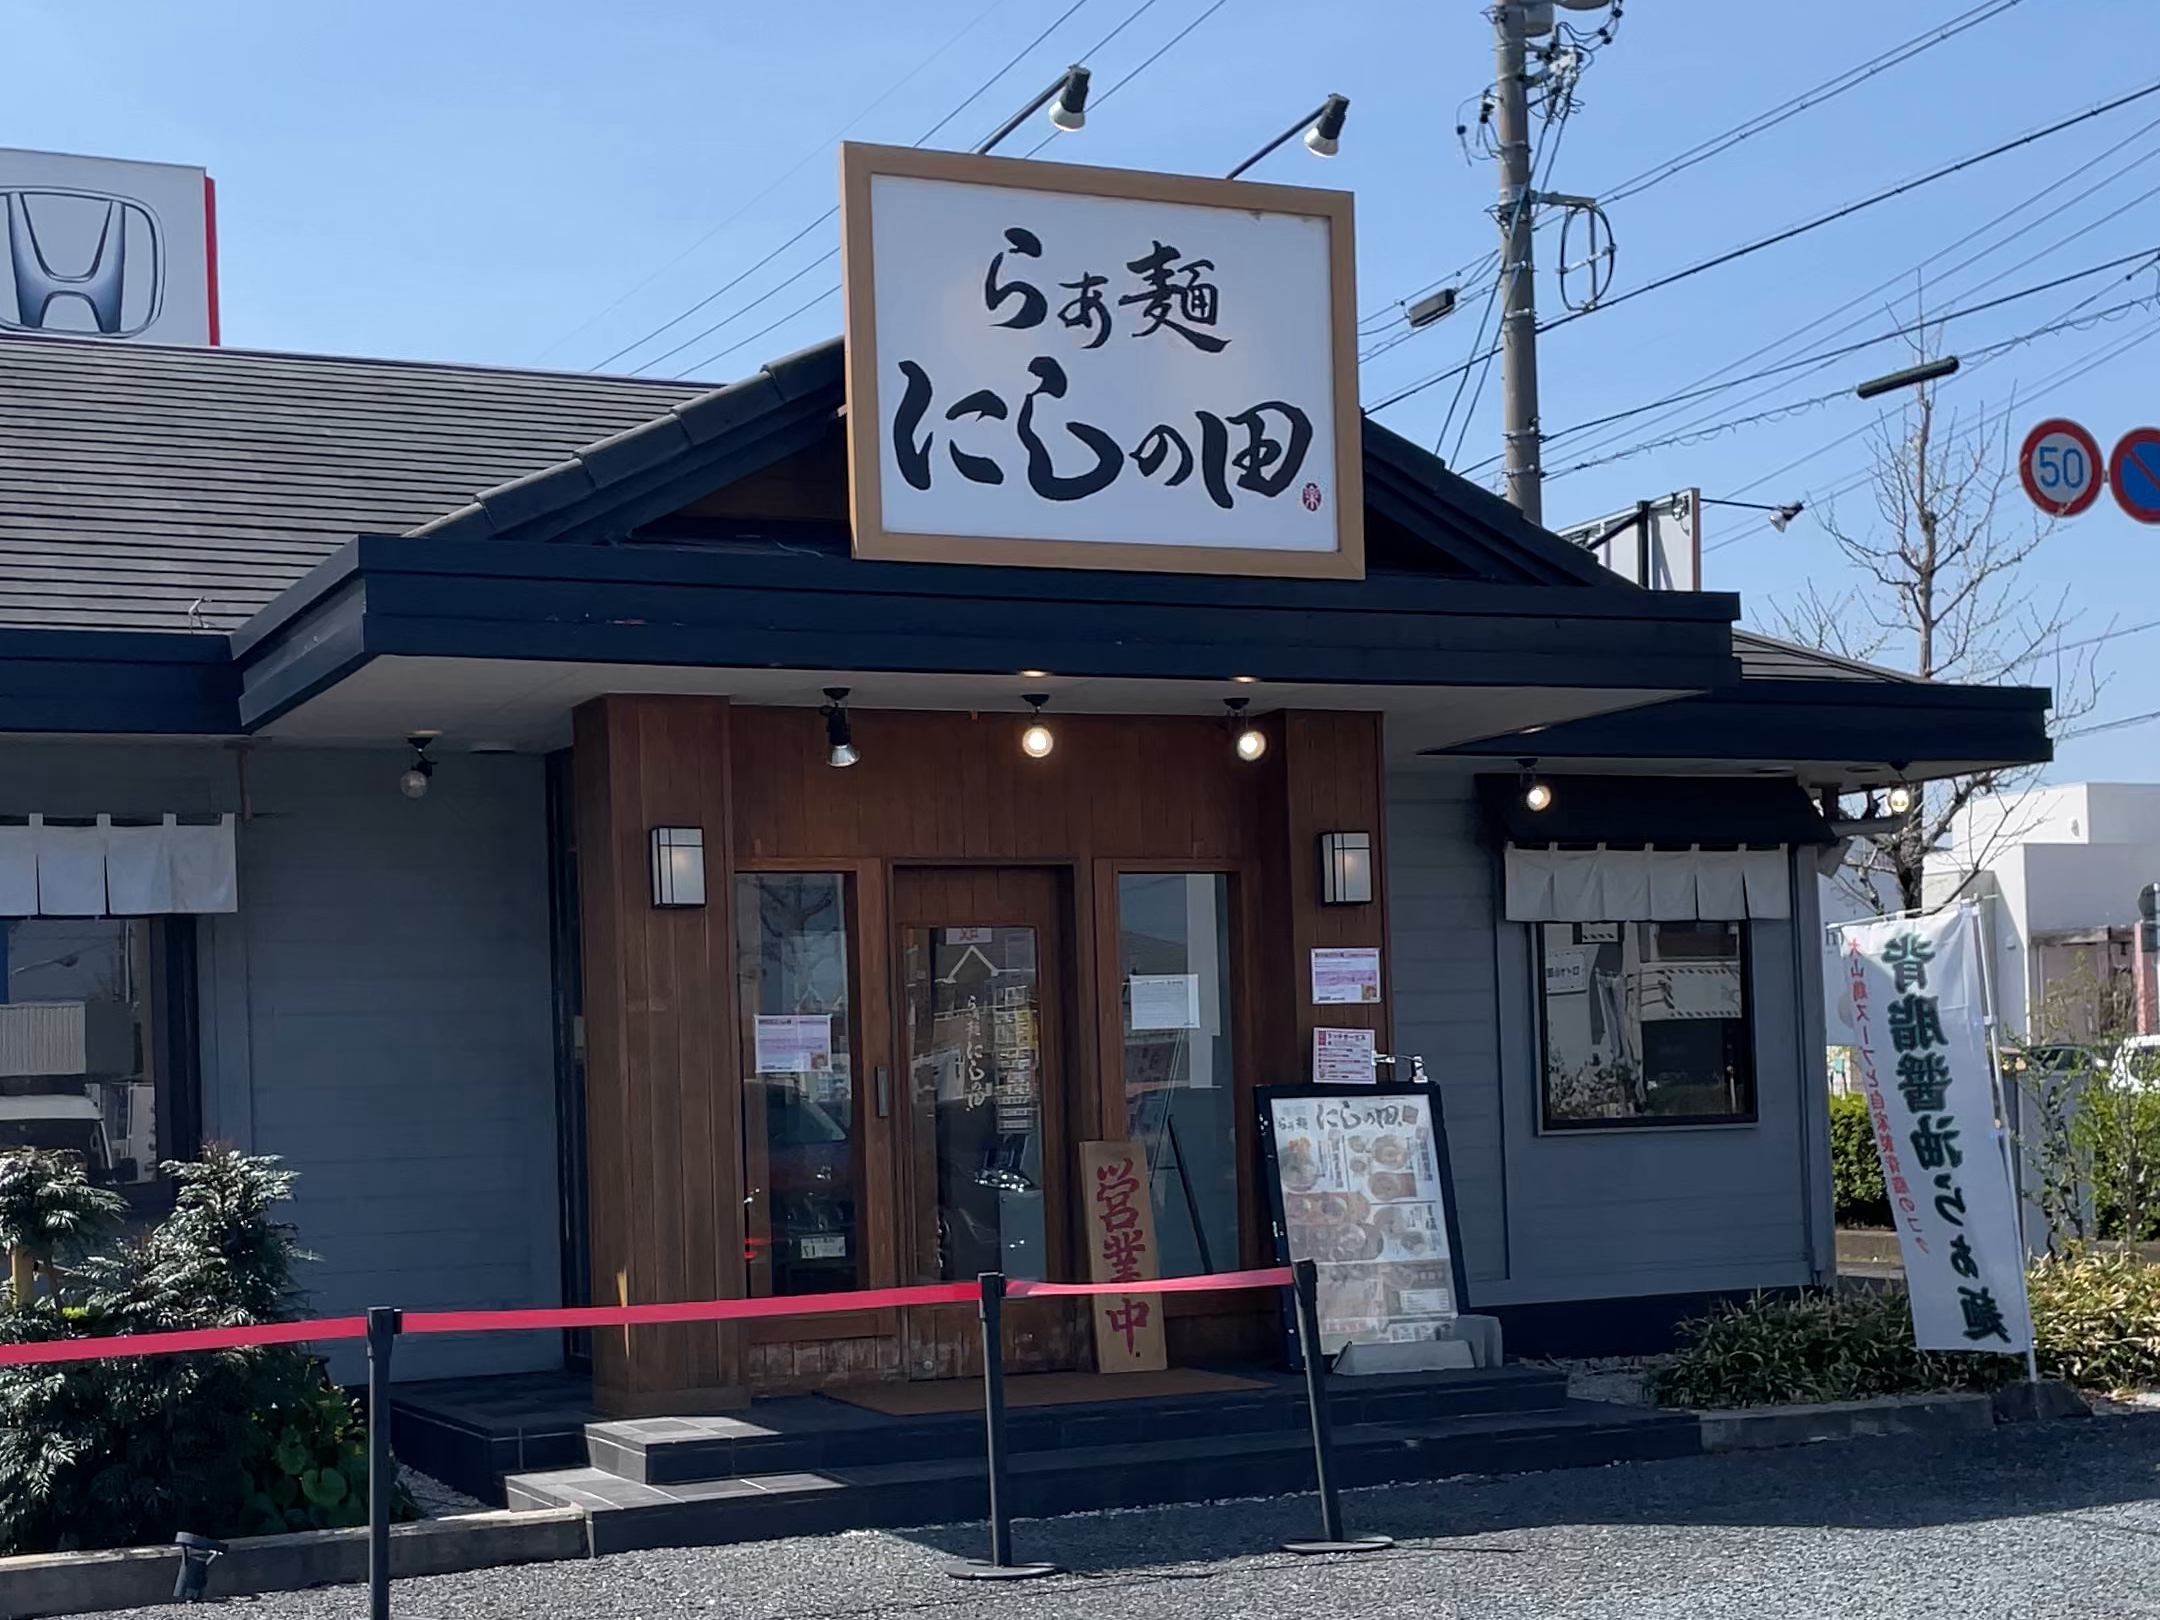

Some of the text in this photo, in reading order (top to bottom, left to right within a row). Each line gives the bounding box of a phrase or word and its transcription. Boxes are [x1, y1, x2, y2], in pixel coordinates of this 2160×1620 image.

[984, 227, 1232, 353] らぁ麺
[2038, 446, 2084, 489] 50
[1096, 1157, 1150, 1356] 営業中
